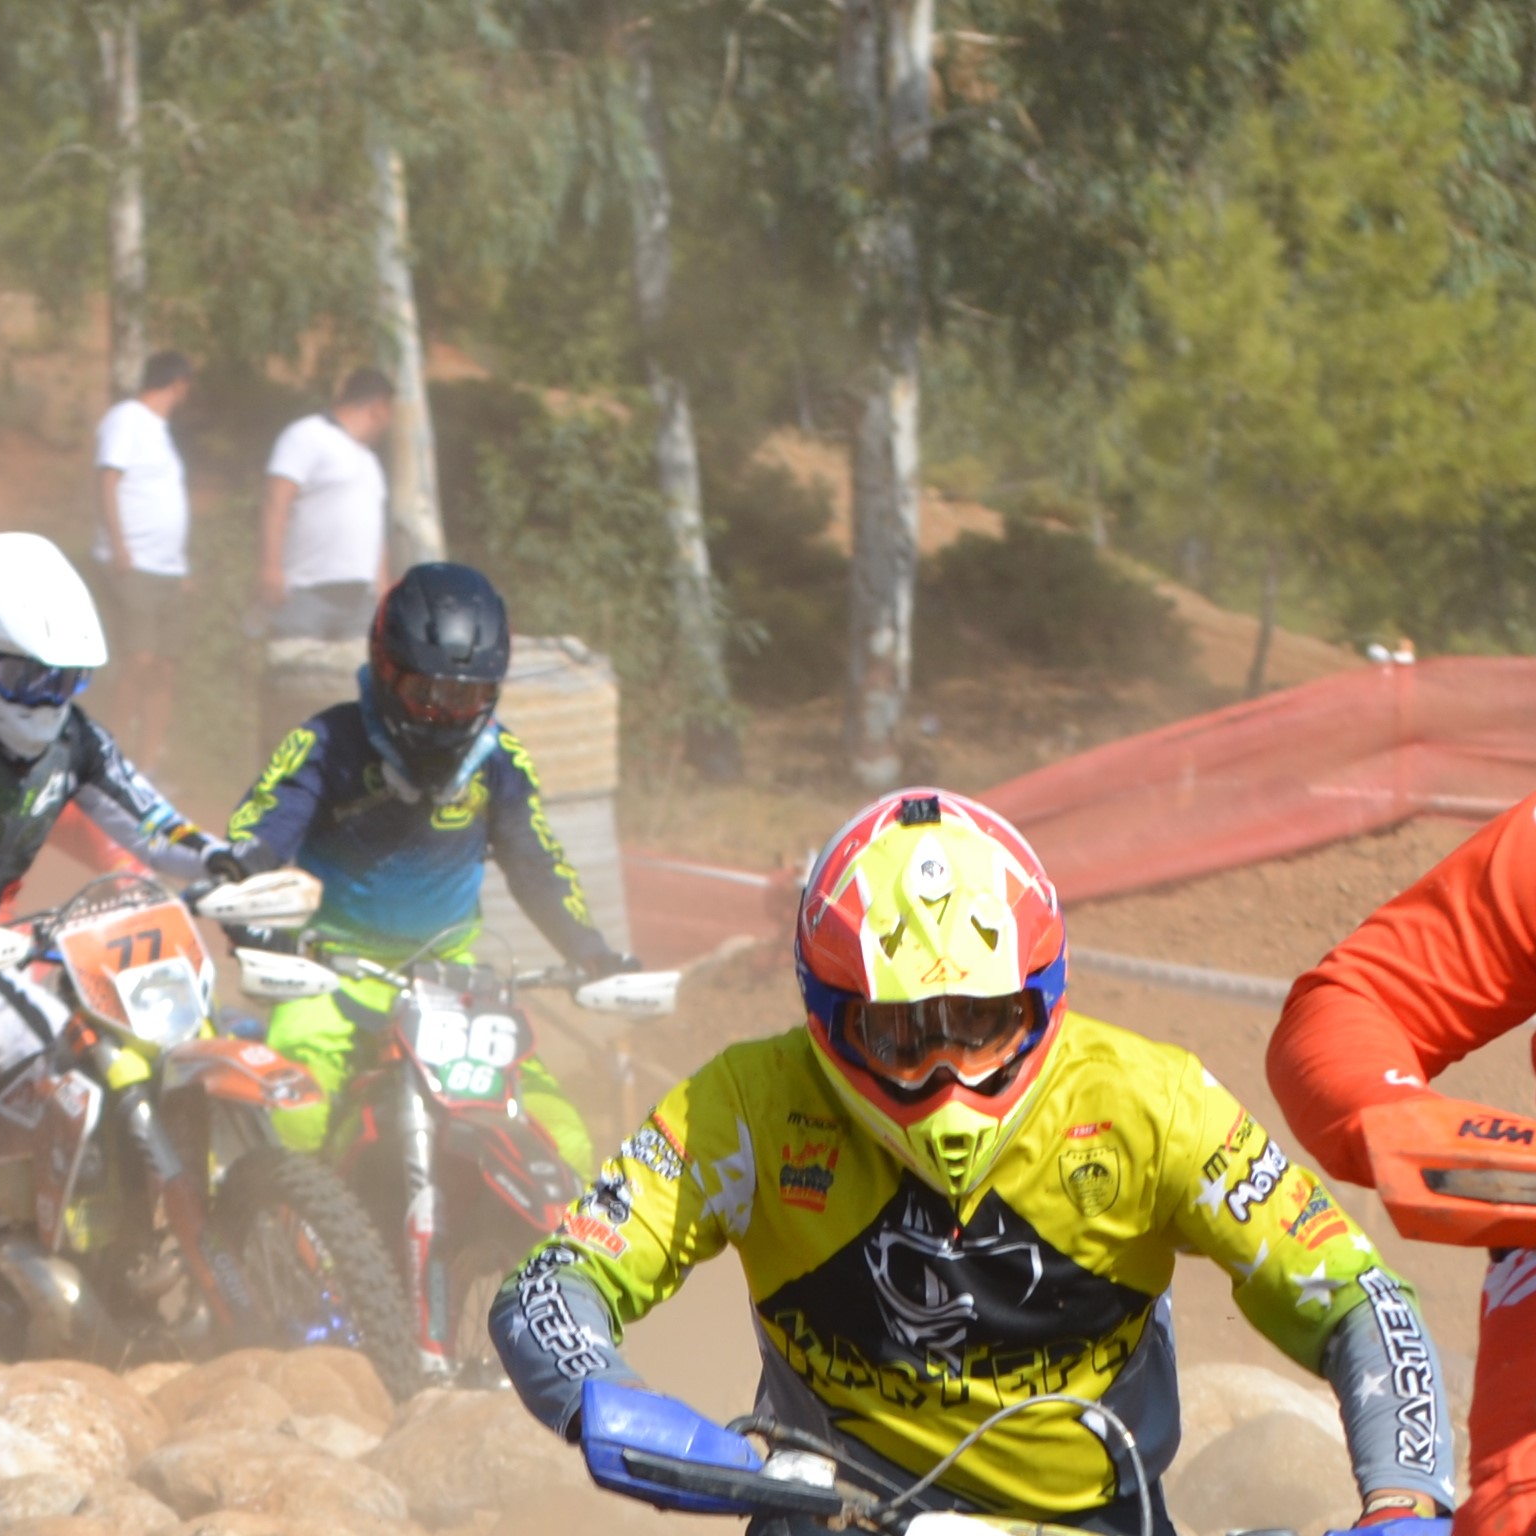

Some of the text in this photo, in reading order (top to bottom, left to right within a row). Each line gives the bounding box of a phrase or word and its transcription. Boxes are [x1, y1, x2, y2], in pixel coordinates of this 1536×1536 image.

[105, 926, 163, 969] 77
[415, 1009, 518, 1067] 66
[446, 1061, 495, 1094] 66
[1457, 1117, 1535, 1147] KTM
